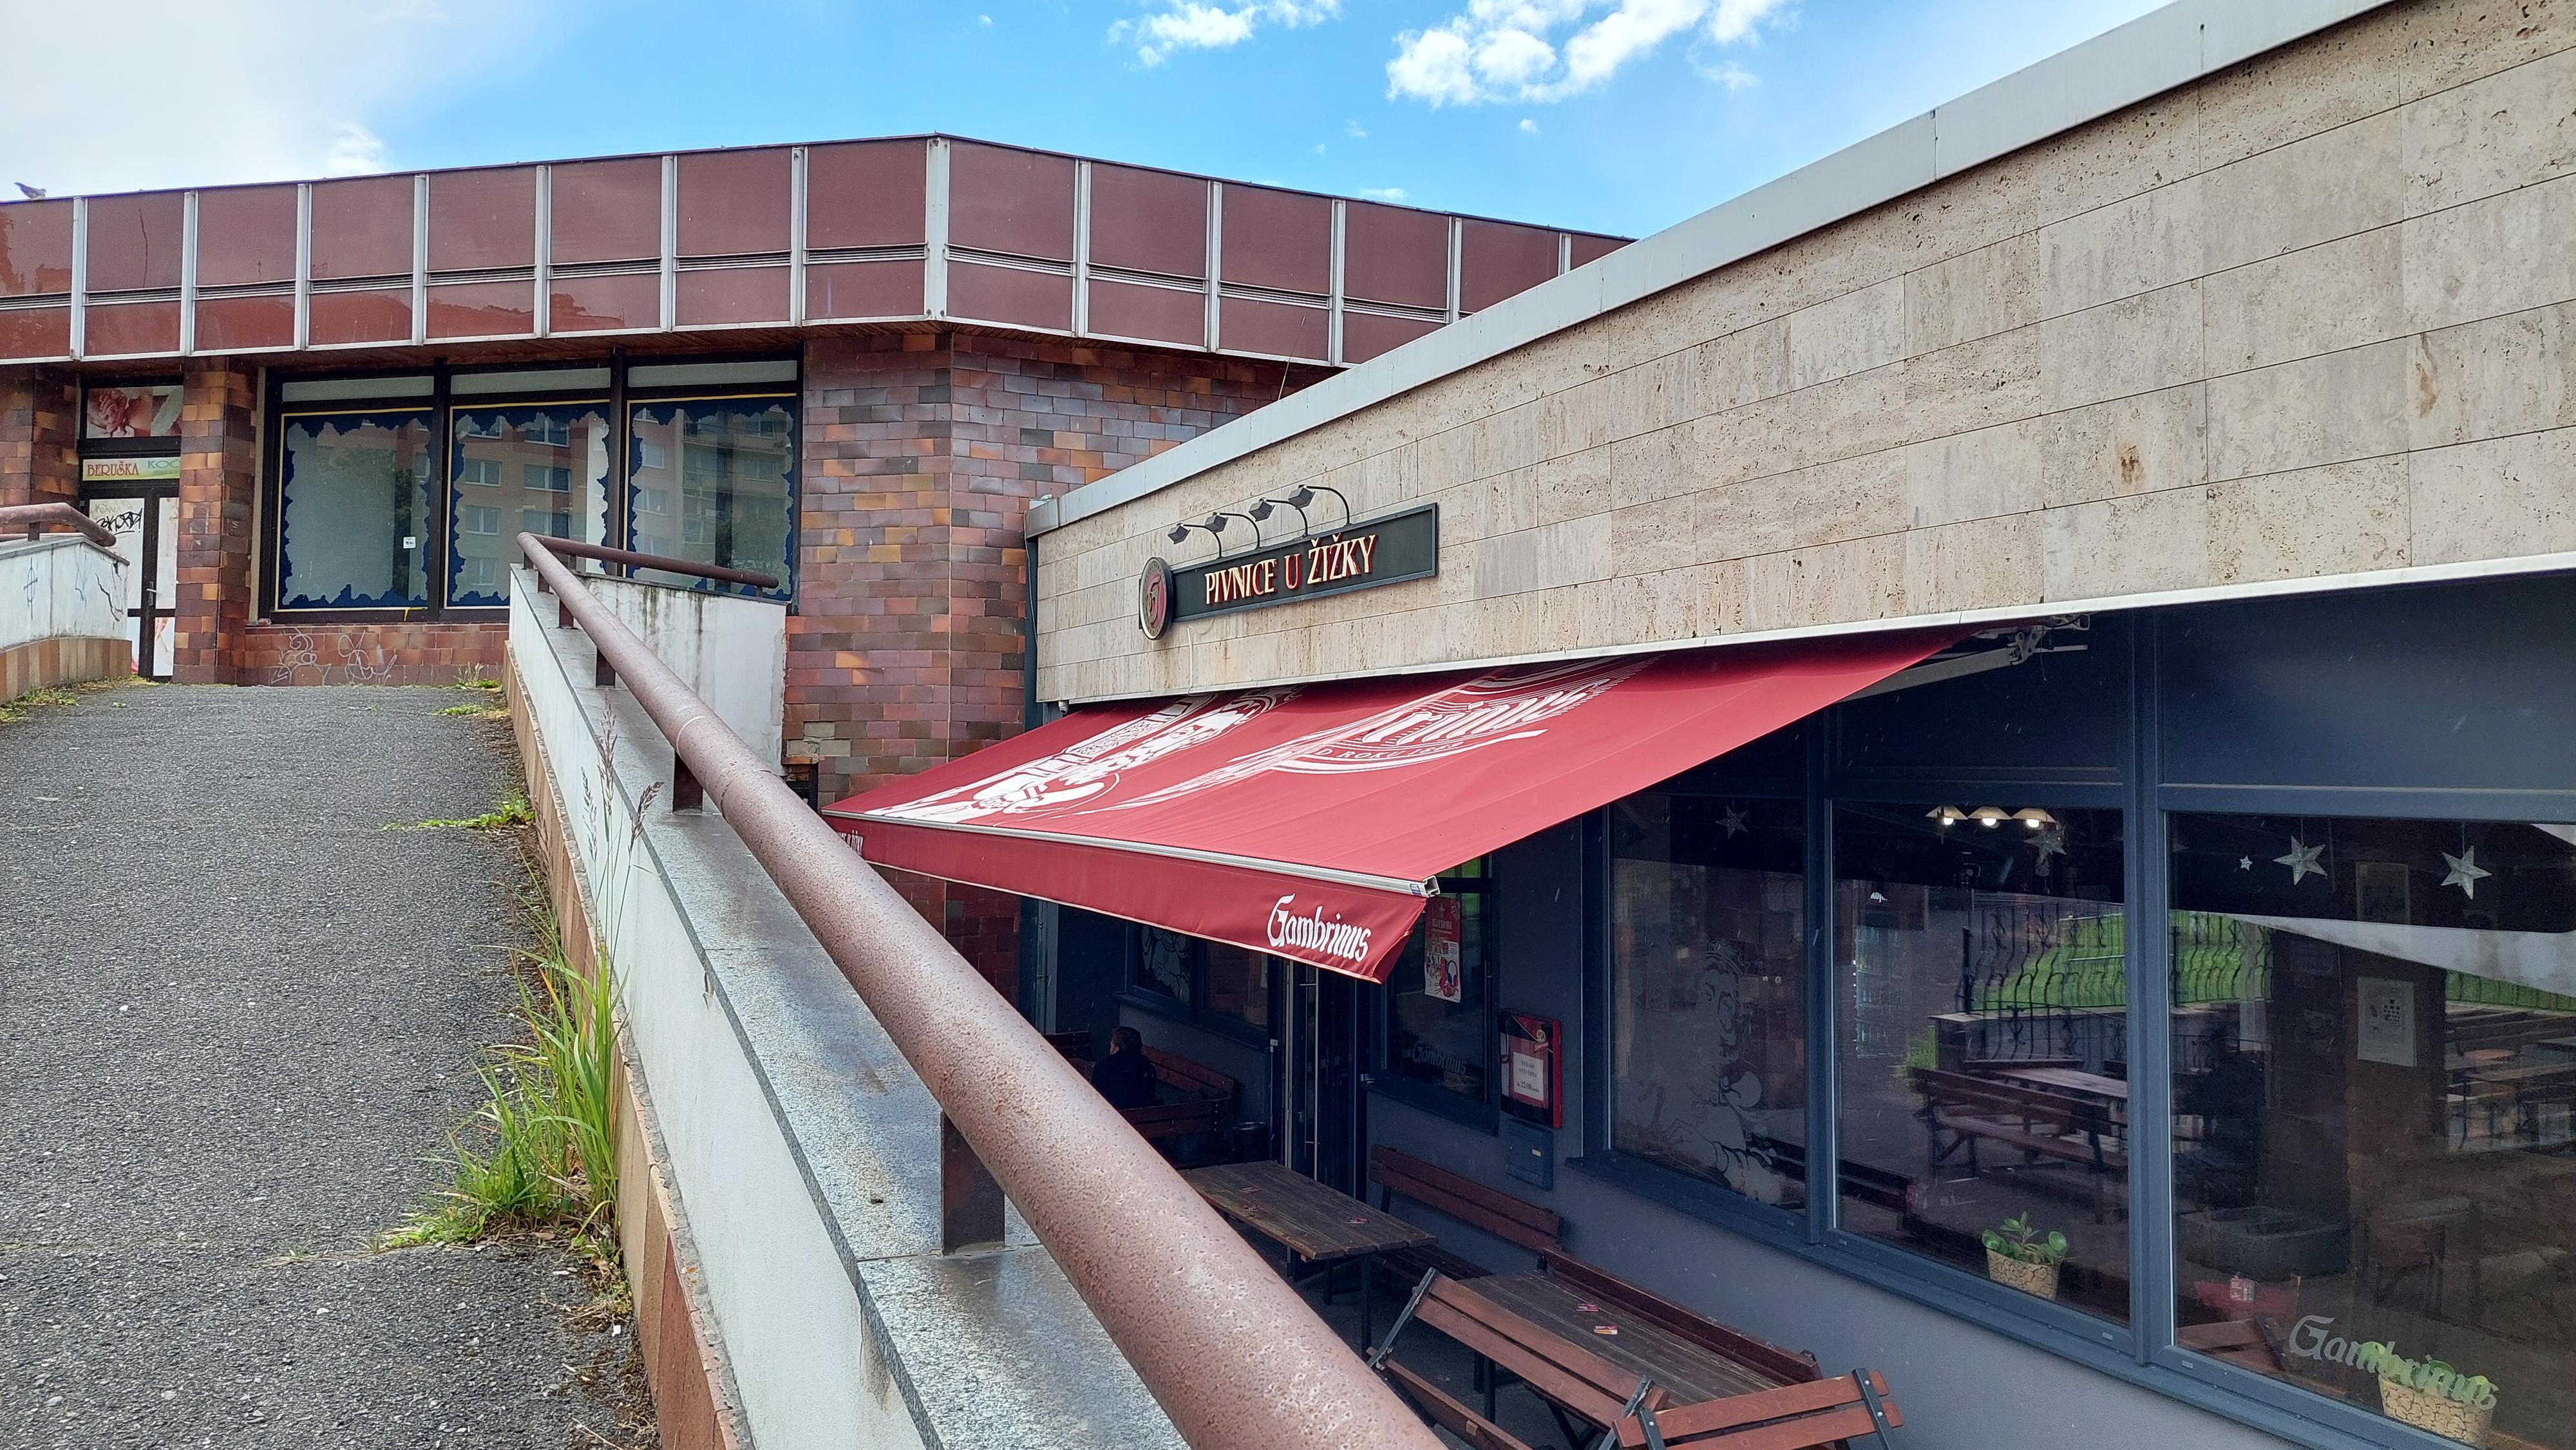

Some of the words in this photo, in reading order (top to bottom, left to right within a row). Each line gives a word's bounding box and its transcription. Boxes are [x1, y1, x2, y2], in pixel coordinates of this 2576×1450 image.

[87, 460, 140, 476] BERUŠKA
[1205, 558, 1278, 605] PIVNICE
[1284, 553, 1302, 590] U
[1307, 532, 1377, 585] ŽIŽKY
[1267, 892, 1372, 963] Gambrinus
[2288, 1315, 2499, 1410] Gambrinus
